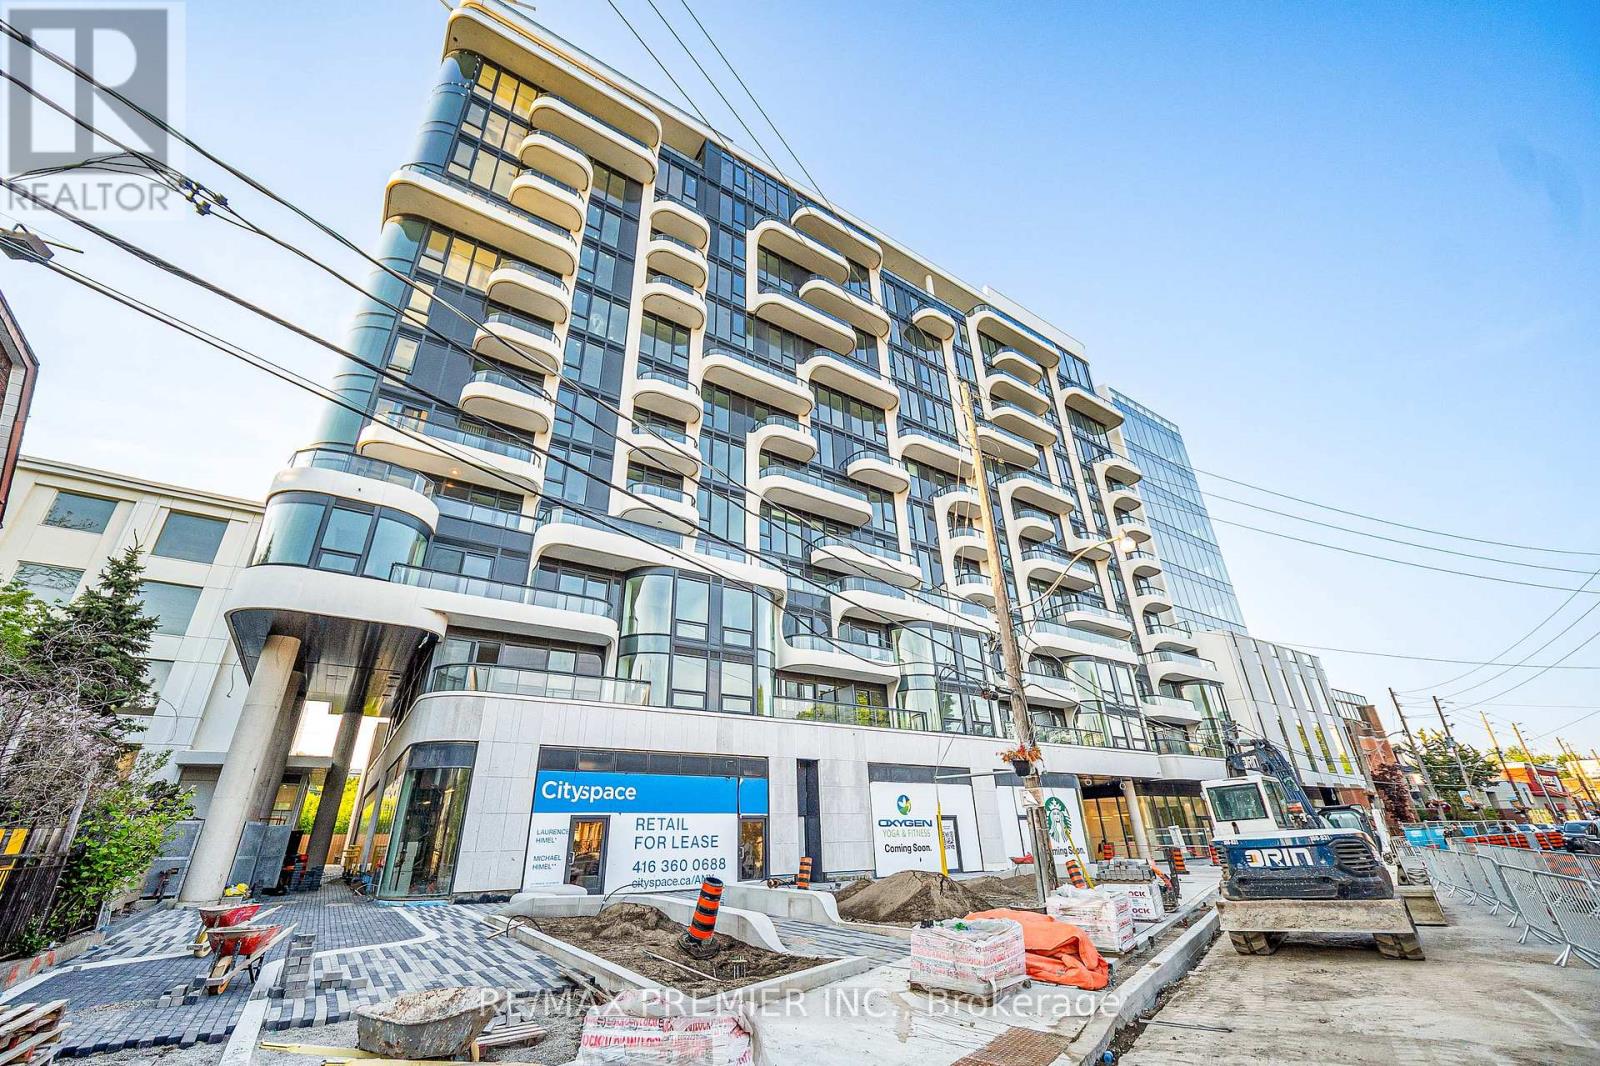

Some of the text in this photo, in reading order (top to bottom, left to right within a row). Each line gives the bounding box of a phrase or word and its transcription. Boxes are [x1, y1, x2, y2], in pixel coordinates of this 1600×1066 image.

[541, 781, 637, 802] Cityspace
[635, 817, 689, 831] RETAIL
[878, 819, 933, 827] OXYGEN
[882, 829, 931, 838] YOGA & FITNESS
[634, 834, 719, 850] FOR LEASE
[884, 843, 932, 855] Coming Soon.
[632, 857, 726, 873] 416 360 0688
